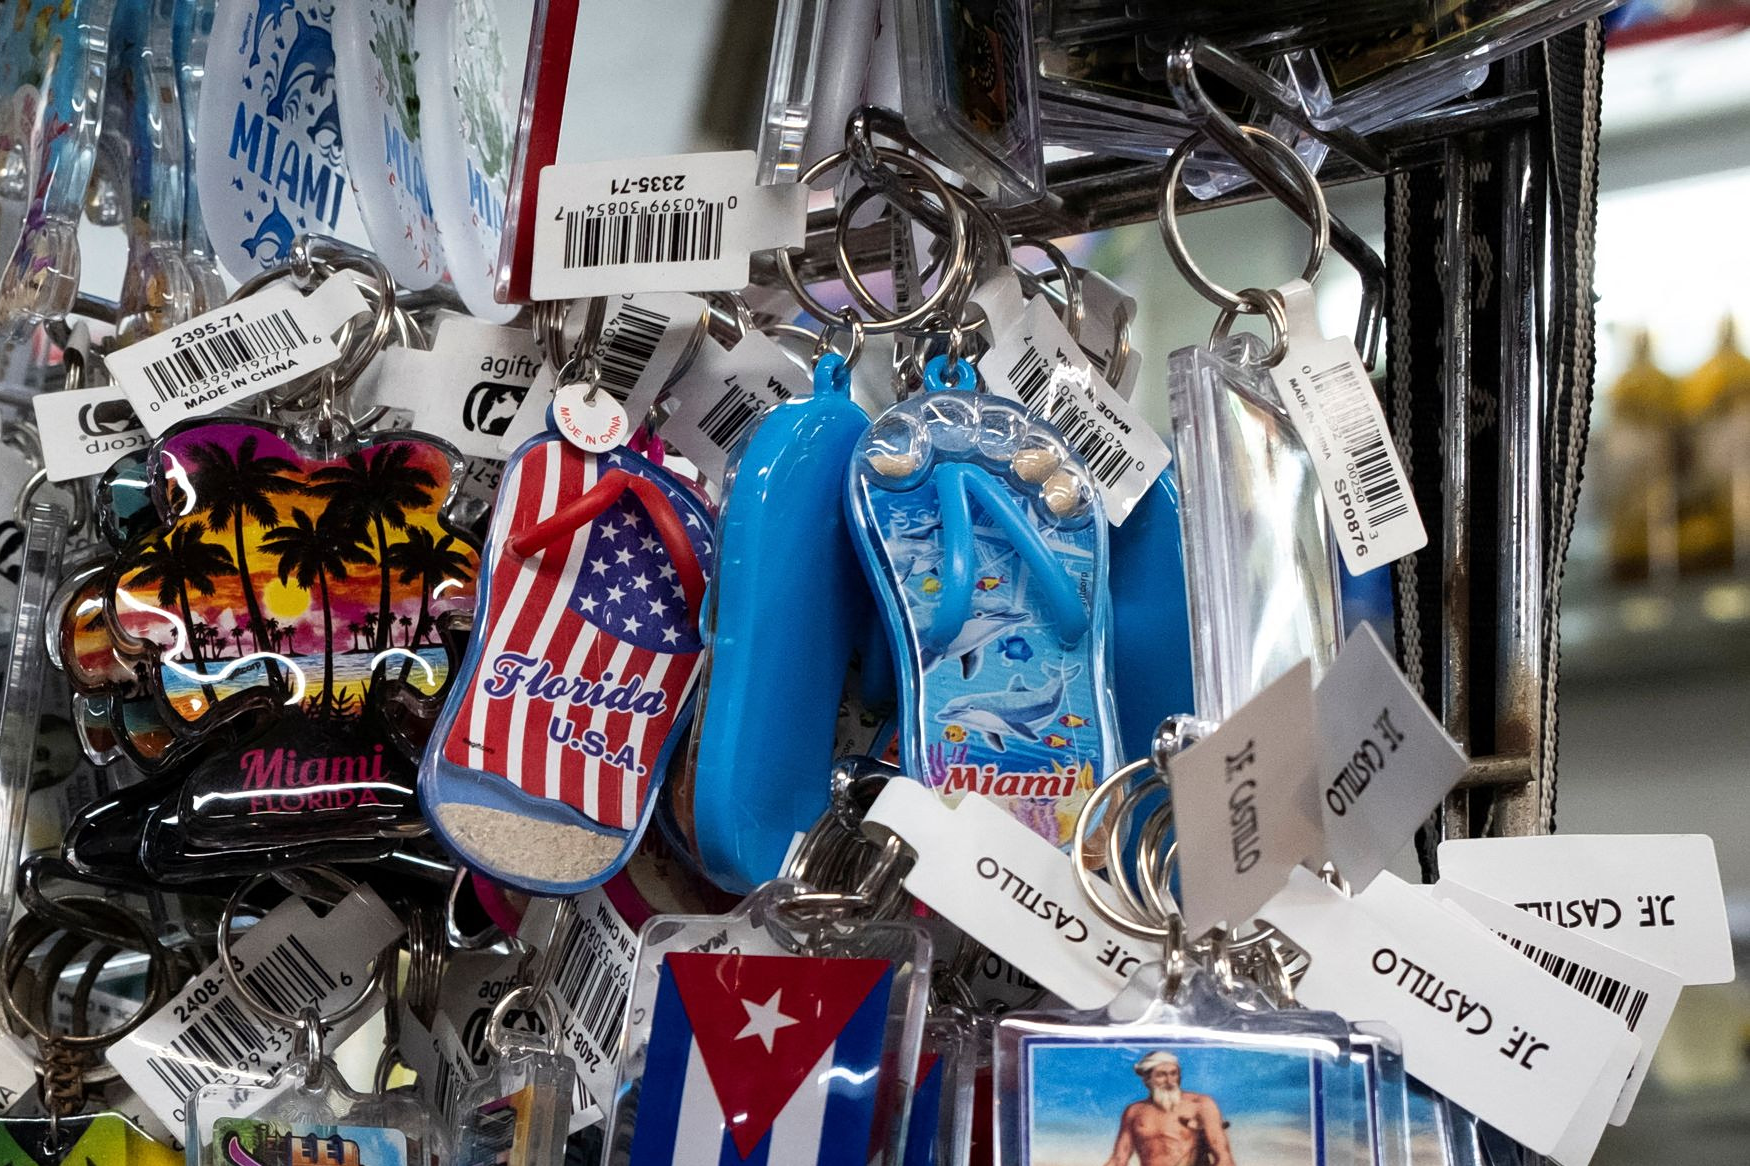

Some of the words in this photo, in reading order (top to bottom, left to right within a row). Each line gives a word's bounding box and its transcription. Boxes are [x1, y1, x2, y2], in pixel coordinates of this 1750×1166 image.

[229, 101, 344, 230] MIAMI
[611, 174, 686, 195] 2335-71
[554, 206, 564, 221] 7
[586, 200, 640, 218] 30854
[650, 197, 706, 213] 40399
[171, 312, 245, 349] 2395-71
[180, 370, 231, 398] 40399
[241, 347, 292, 372] 19777
[312, 334, 322, 345] 6
[184, 385, 230, 411] MADE
[232, 376, 248, 390] IN
[250, 358, 299, 383] CHINA
[480, 355, 540, 379] agiftc
[1288, 377, 1309, 409] MADE
[560, 405, 581, 437] MADE
[586, 434, 597, 445] IN
[600, 413, 622, 444] CHINA
[1079, 410, 1123, 448] 40399
[1096, 403, 1132, 435] MADE
[85, 434, 149, 455] tcorp
[1345, 462, 1366, 504] 00250
[1334, 479, 1368, 558] SP0876
[483, 653, 666, 716] Florida
[549, 716, 646, 775] U.S.A.
[240, 744, 392, 790] Miami
[944, 765, 1078, 798] Miami
[1326, 739, 1384, 817] CASTILLO
[251, 788, 380, 813] FLORIDA
[1229, 780, 1262, 874] CASTILLO
[976, 857, 1089, 943] CASTILLO
[1636, 895, 1675, 928] J.F.
[597, 902, 620, 939] CHINA
[583, 918, 613, 966] 33086
[618, 938, 631, 950] IN
[1096, 940, 1141, 978] J.F.
[174, 956, 245, 1023] 2408-3
[1372, 947, 1493, 1035] CASTILLO
[562, 1014, 601, 1074] 2408-71
[1500, 1026, 1549, 1070] J.F.
